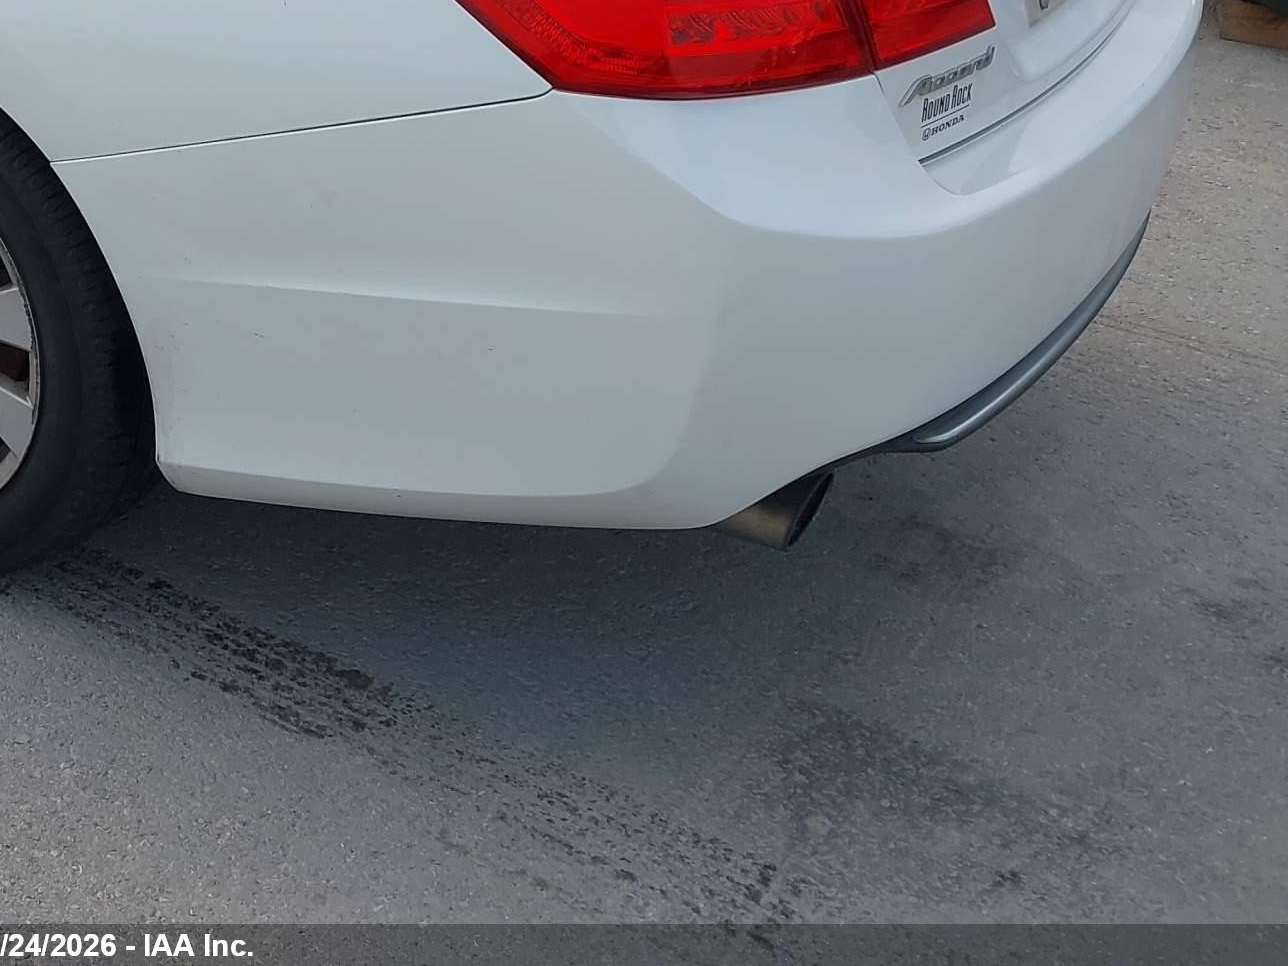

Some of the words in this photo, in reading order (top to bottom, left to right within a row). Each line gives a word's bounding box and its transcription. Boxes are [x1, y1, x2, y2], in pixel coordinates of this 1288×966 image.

[899, 45, 996, 105] Accord
[921, 93, 951, 123] ROUND
[952, 82, 974, 109] ROCK
[931, 114, 965, 136] HONDA
